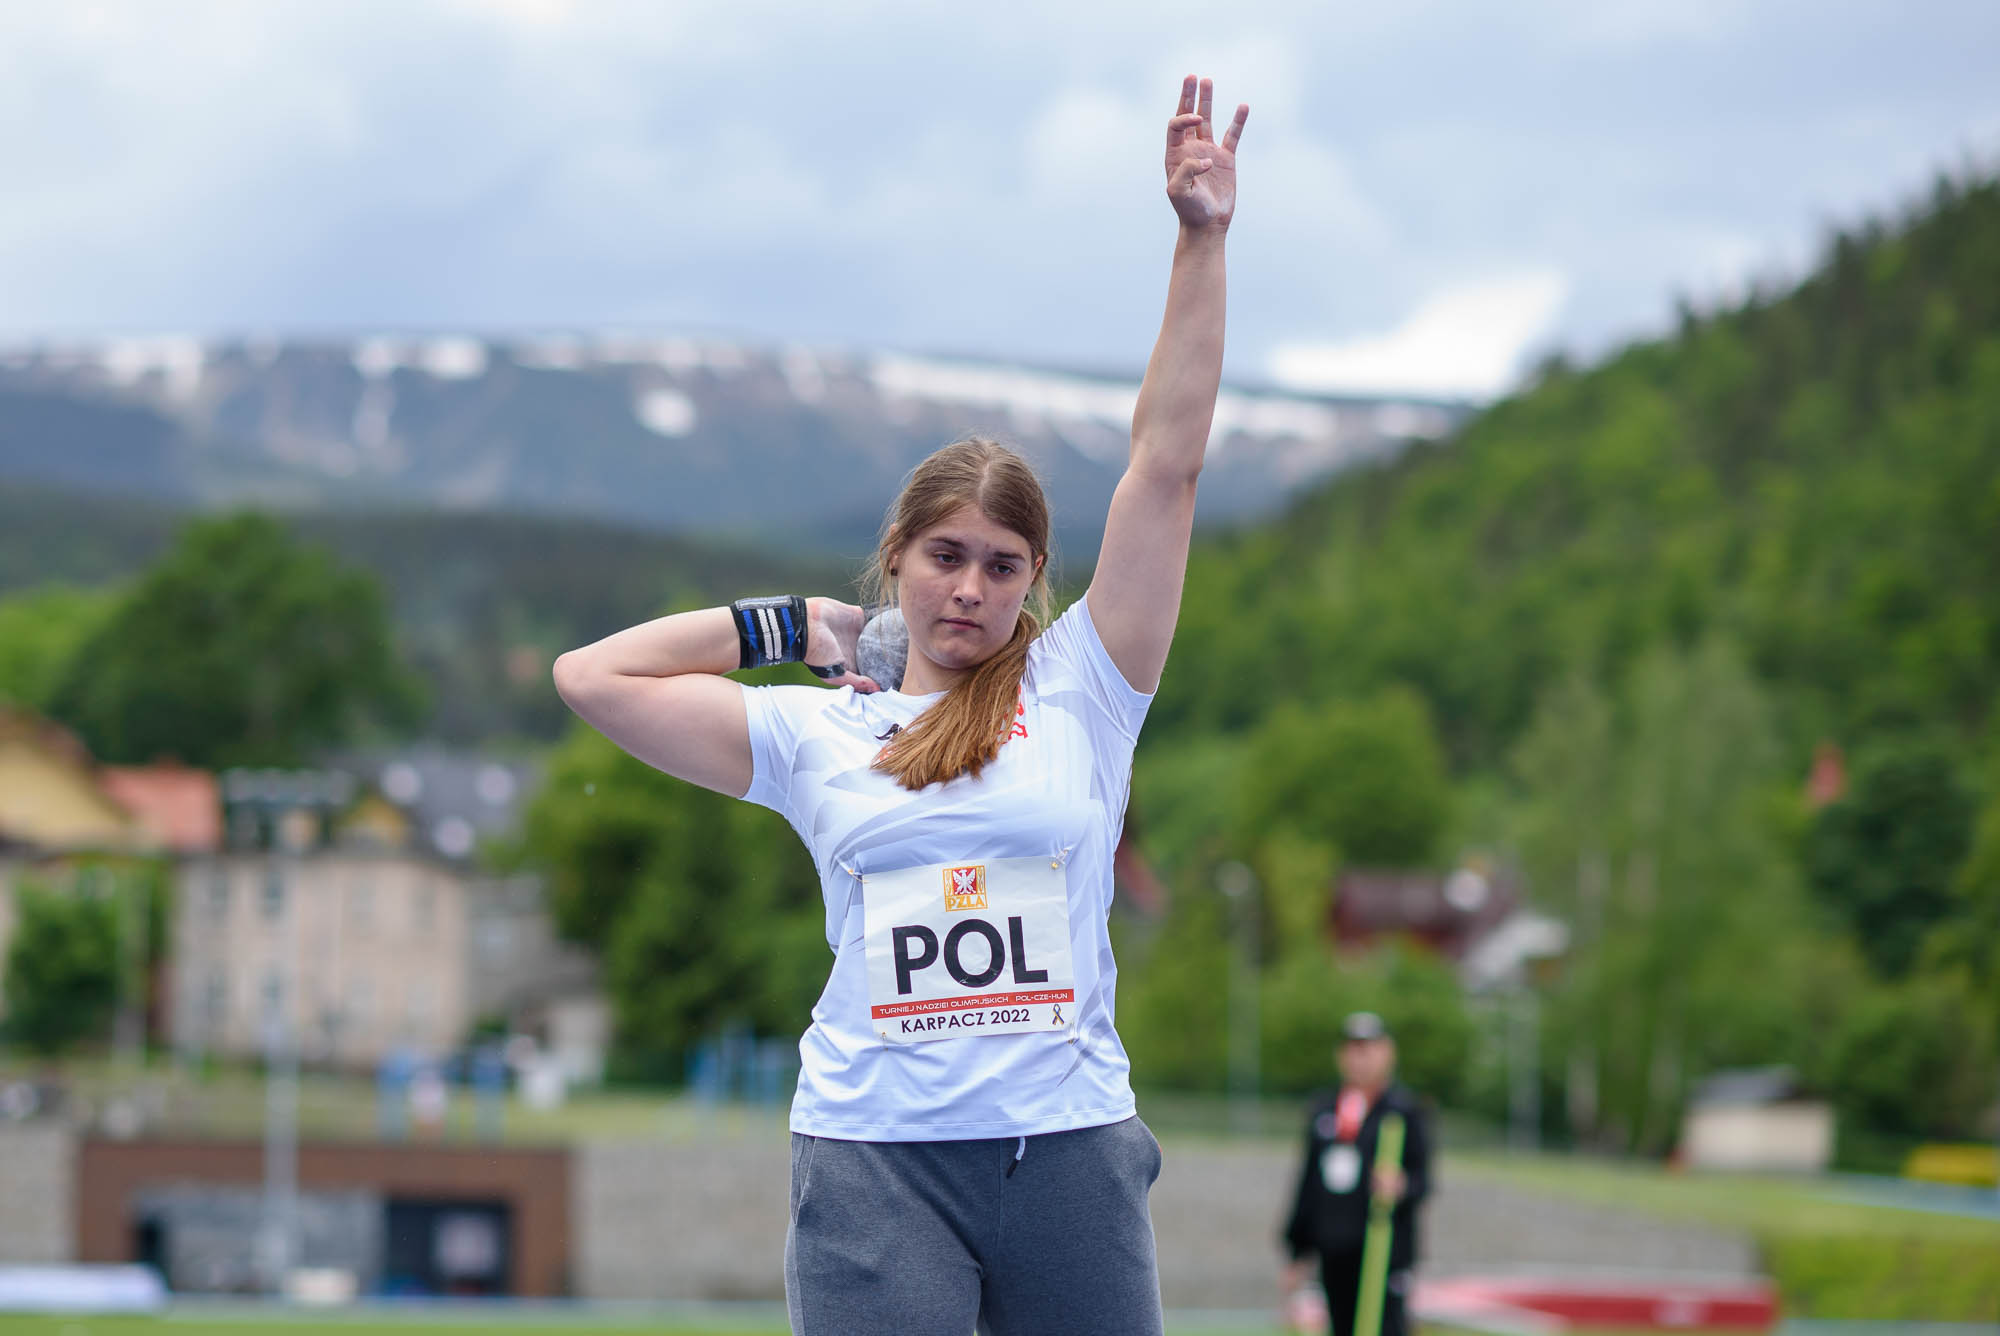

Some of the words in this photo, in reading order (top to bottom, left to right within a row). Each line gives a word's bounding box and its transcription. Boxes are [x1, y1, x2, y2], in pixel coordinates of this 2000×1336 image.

[948, 896, 985, 909] PZLA
[892, 916, 1049, 996] POL
[880, 1005, 915, 1015] TURNIEJ
[916, 1001, 949, 1011] NADZIEI
[950, 996, 1009, 1008] OLIMPIJSKICH
[1015, 992, 1068, 1002] POL-CZE-HUN
[901, 1012, 986, 1033] KARPACZ
[990, 1008, 1031, 1025] 2022
